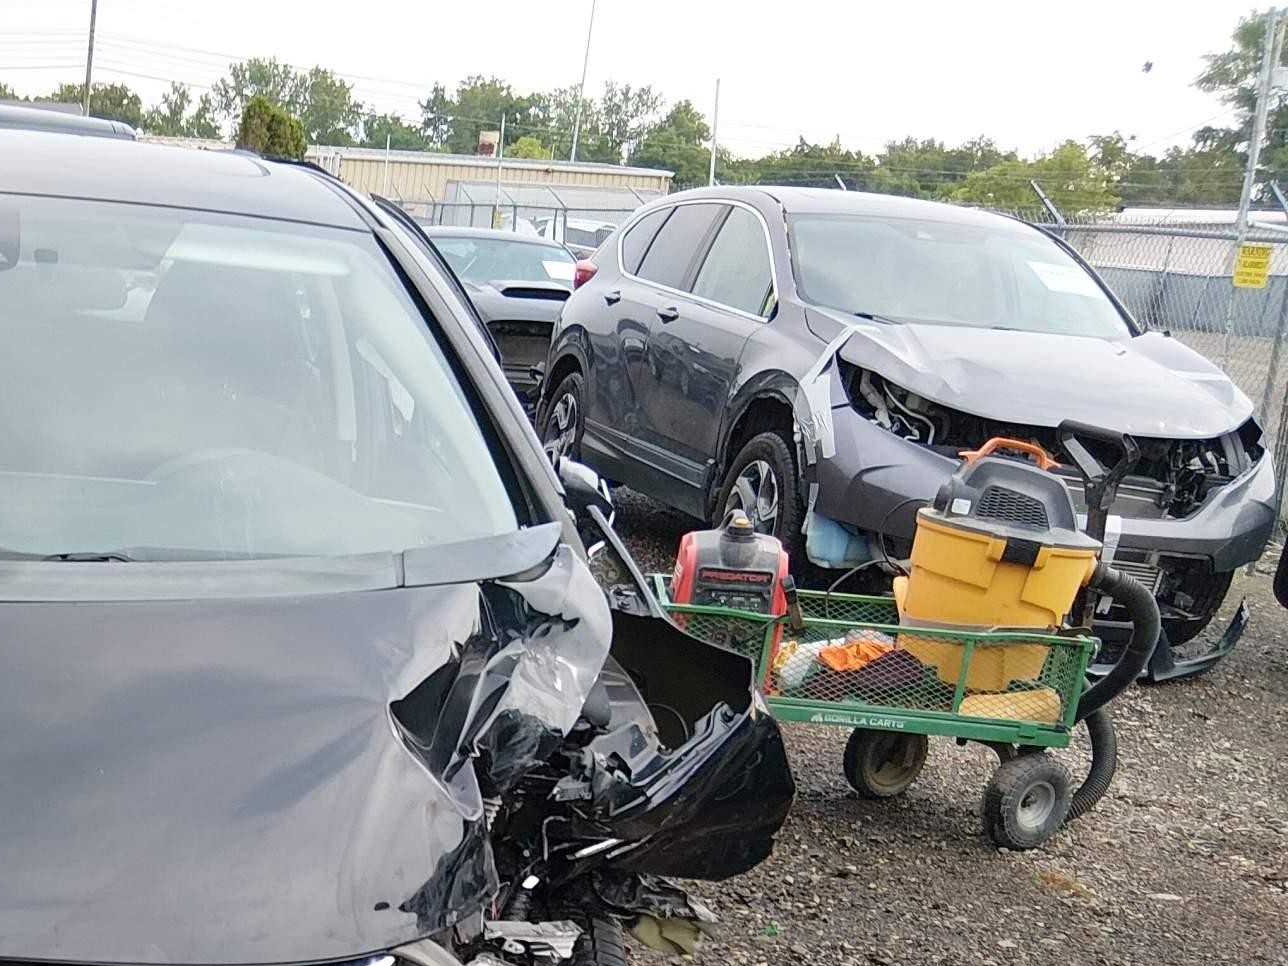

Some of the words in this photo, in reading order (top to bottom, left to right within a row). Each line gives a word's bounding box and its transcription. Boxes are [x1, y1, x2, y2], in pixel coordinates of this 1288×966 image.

[701, 570, 768, 583] PREDATOR
[824, 713, 868, 725] GORILLA
[869, 719, 906, 729] CARTS
